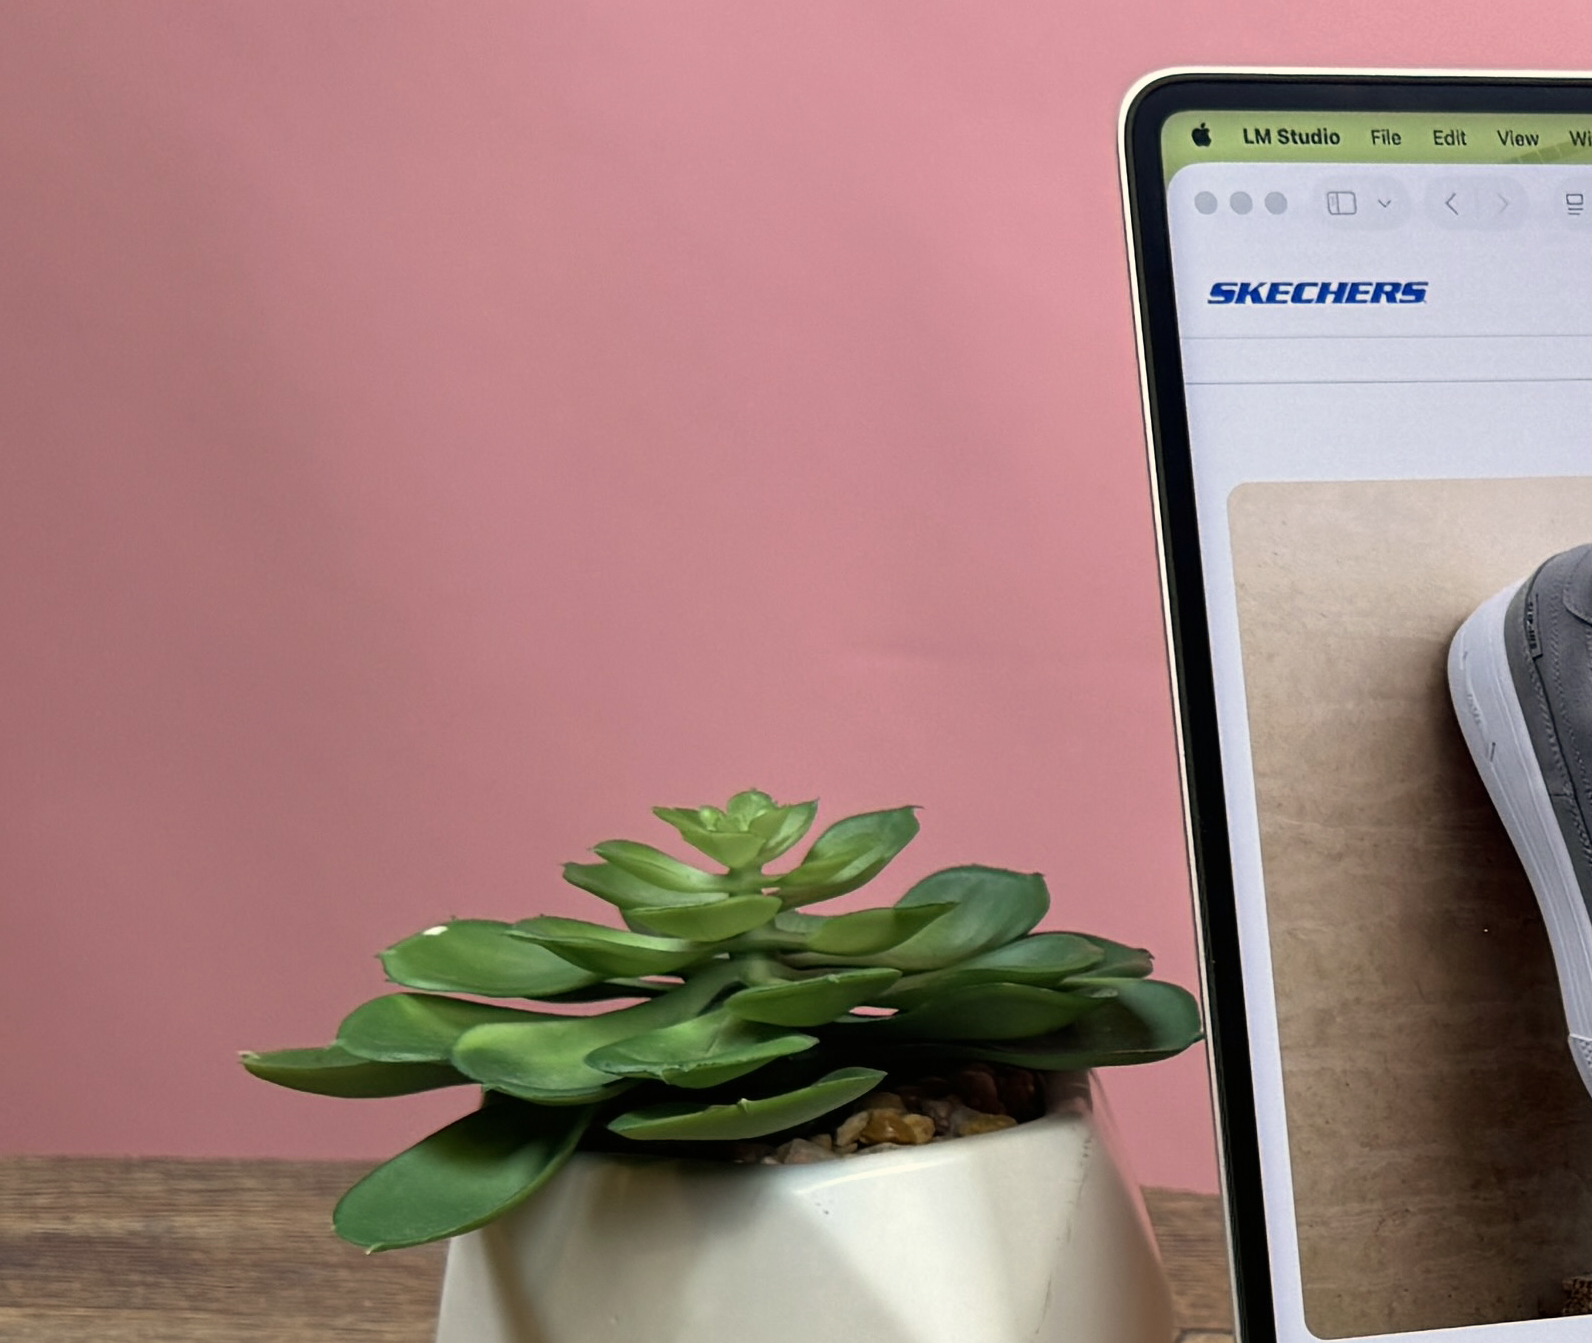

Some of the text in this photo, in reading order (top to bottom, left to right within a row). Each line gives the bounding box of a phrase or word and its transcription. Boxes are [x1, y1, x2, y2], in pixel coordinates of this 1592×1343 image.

[1243, 127, 1340, 145] LM Studio
[1371, 128, 1401, 145] File
[1433, 129, 1466, 145] Edit
[1497, 131, 1539, 147] View
[1207, 281, 1429, 304] SKECHERS
